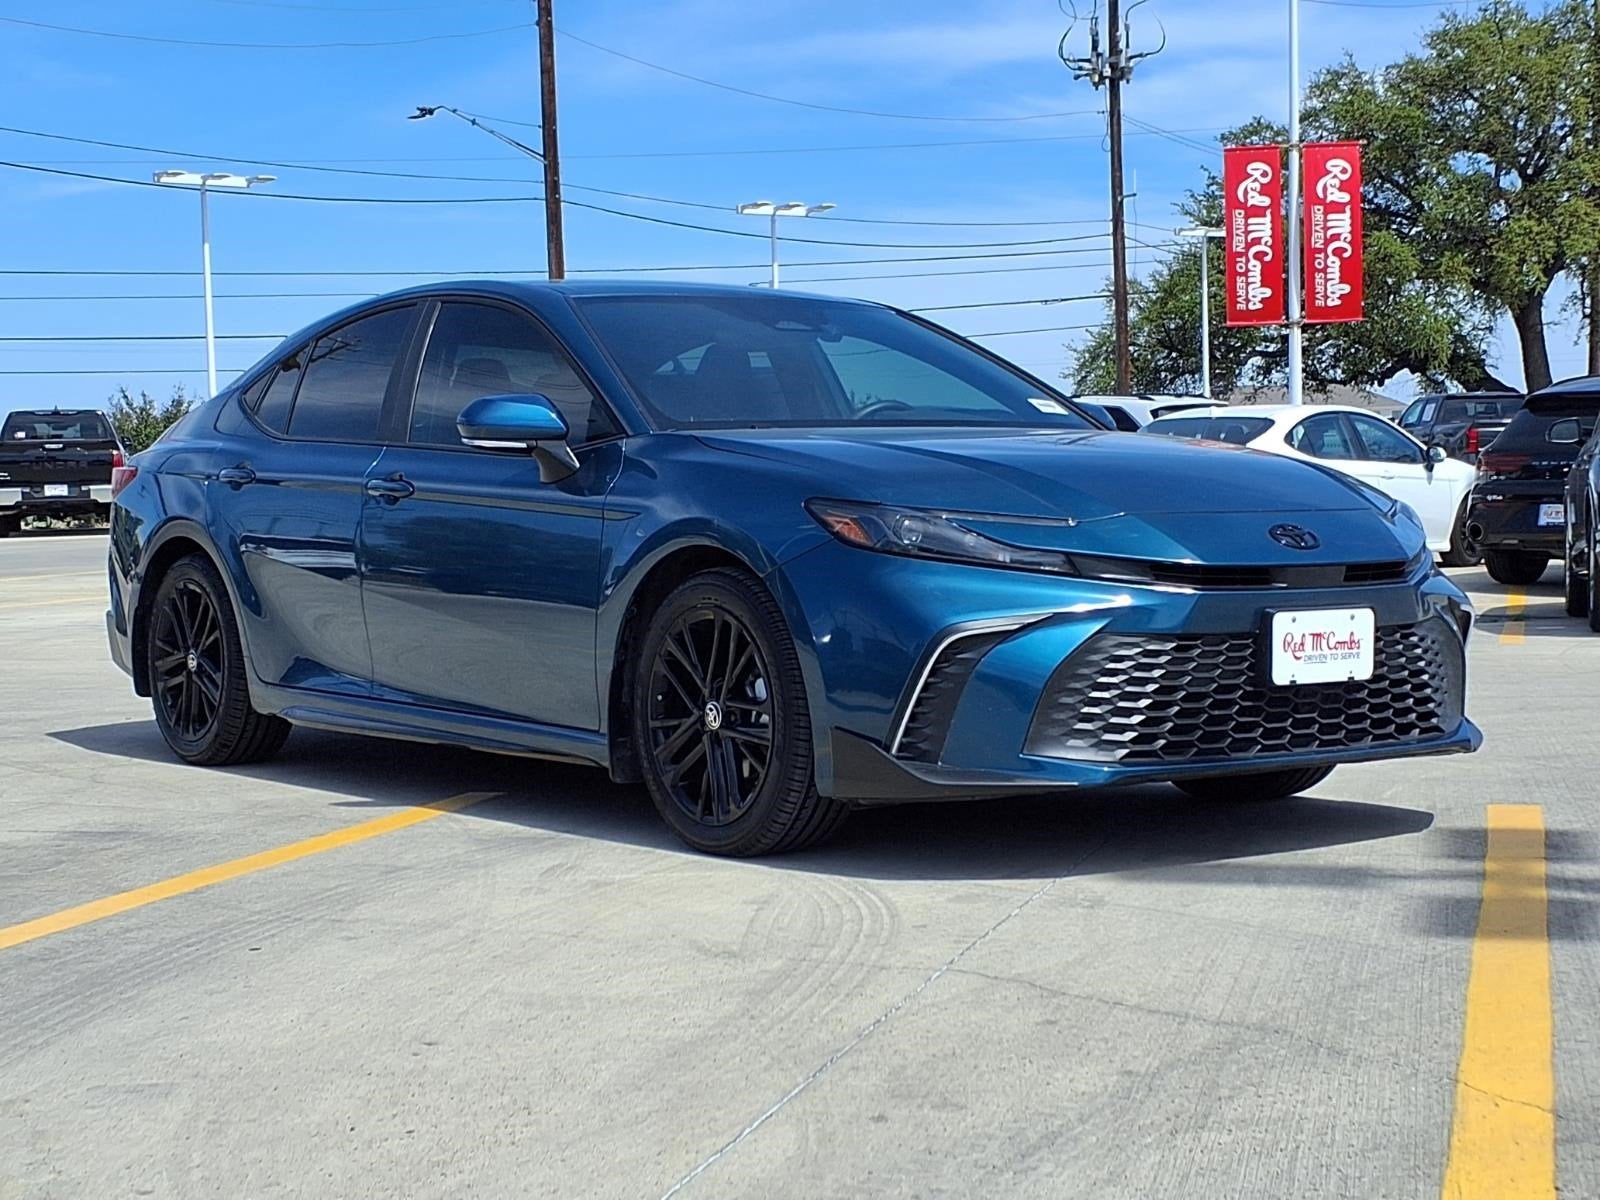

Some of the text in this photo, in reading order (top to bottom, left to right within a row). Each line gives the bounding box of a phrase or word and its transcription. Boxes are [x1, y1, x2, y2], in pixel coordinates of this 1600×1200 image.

[1235, 209, 1247, 310] DRIVEN TO SERVE
[1237, 161, 1273, 310] Red McCombs
[1314, 205, 1325, 307] DRIVEN TO SERVE
[1316, 158, 1352, 307] Red McCombs
[1283, 631, 1361, 661] Red McCombs
[1303, 653, 1328, 662] DRIVEN
[1340, 652, 1361, 660] SERVE
